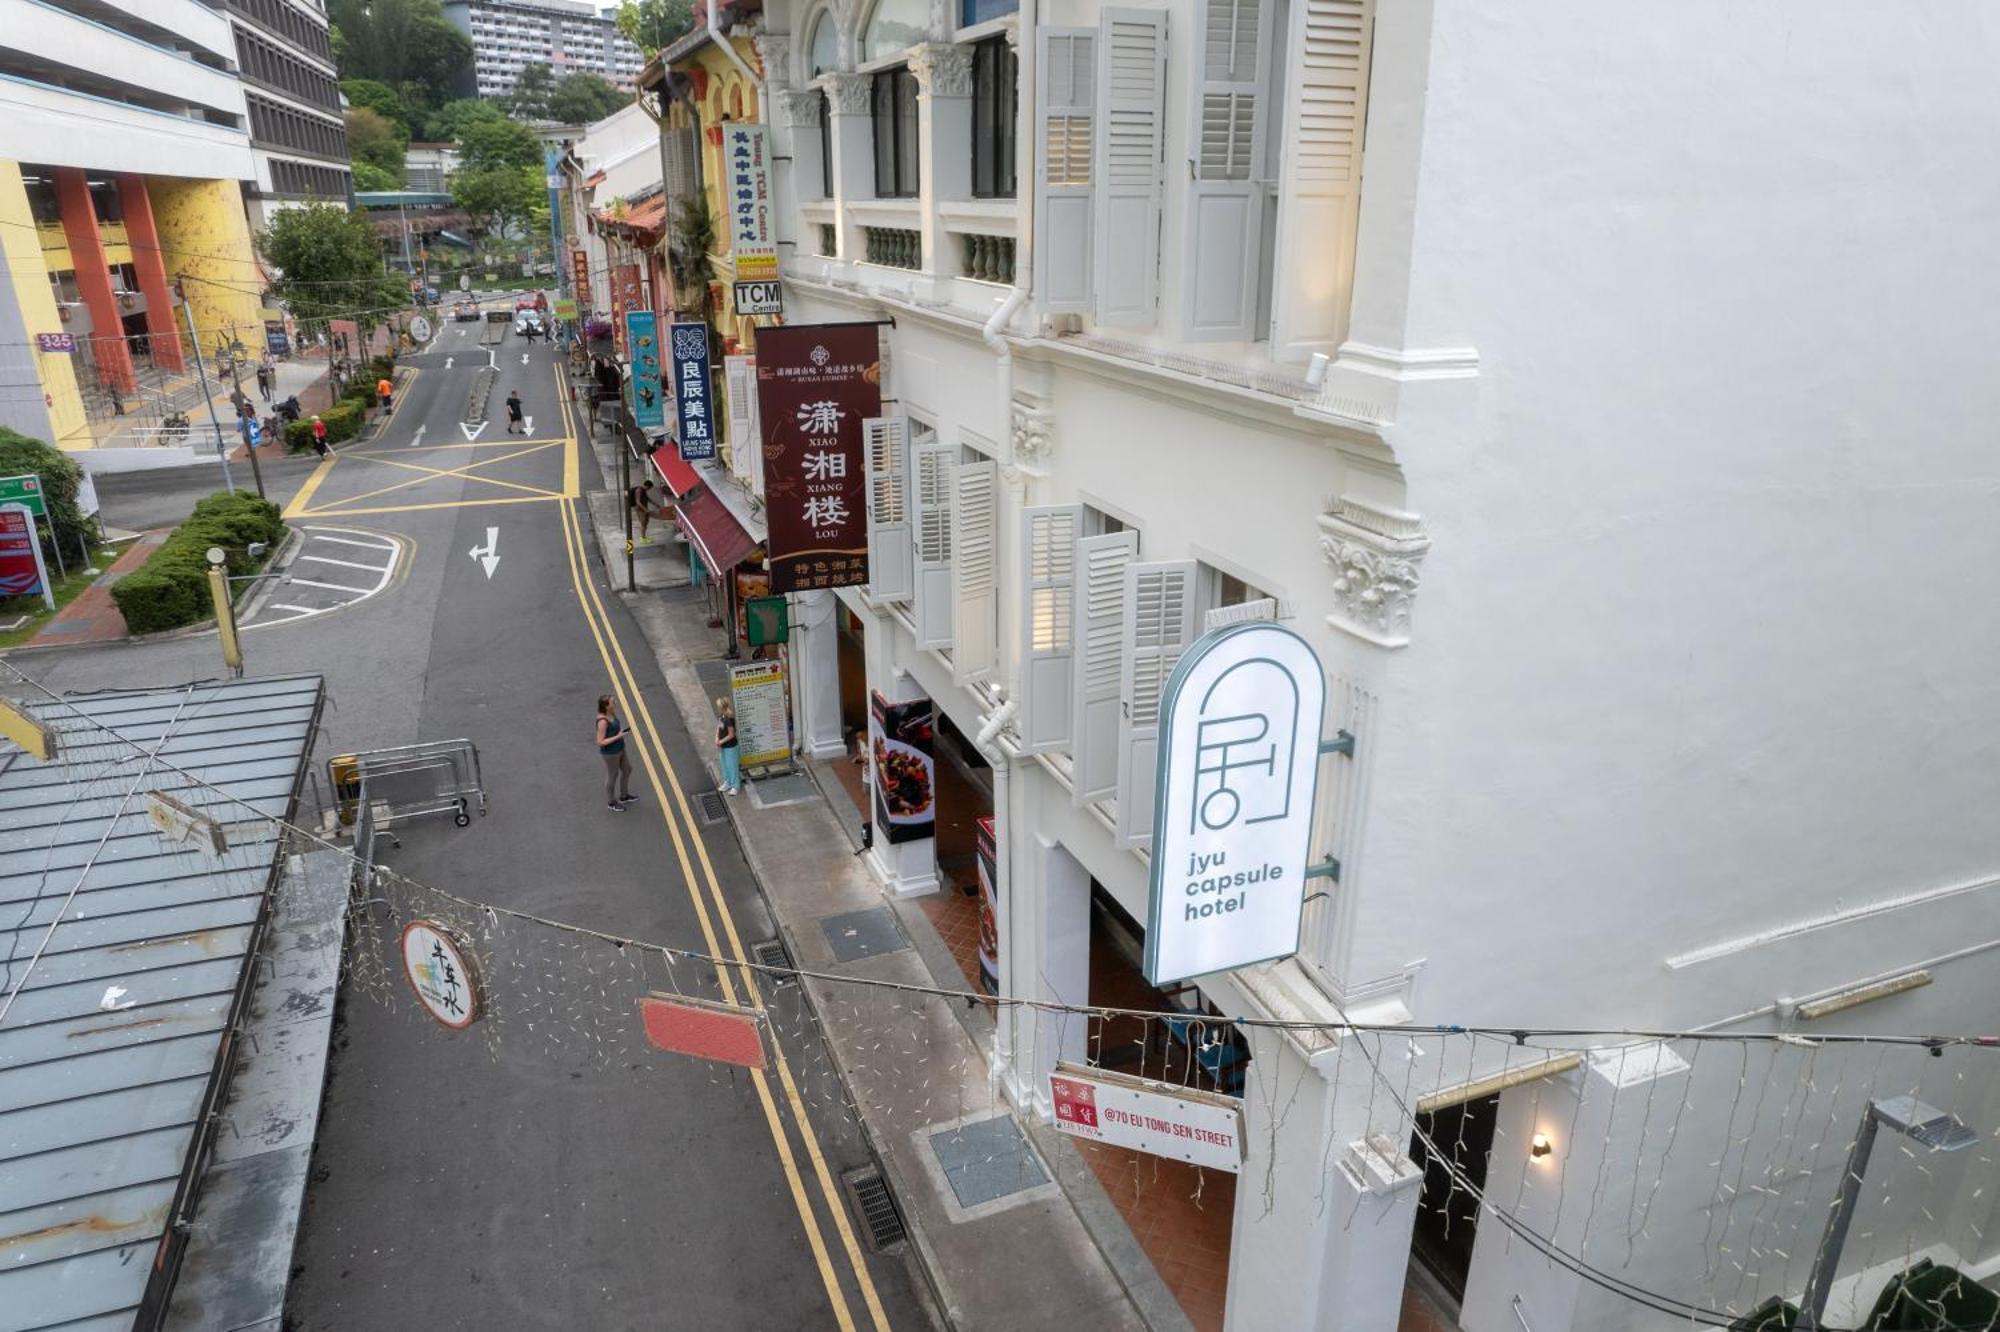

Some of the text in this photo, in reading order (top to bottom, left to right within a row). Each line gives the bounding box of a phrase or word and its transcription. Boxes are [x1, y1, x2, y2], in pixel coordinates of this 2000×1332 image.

[737, 284, 780, 304] TCM
[752, 304, 780, 313] Centre
[682, 361, 708, 438] 良辰美點
[808, 438, 838, 447] XIAO
[807, 483, 843, 493] XIANG
[815, 530, 838, 539] LOU
[1187, 851, 1225, 877] jyu
[1185, 863, 1284, 896] capsule
[1184, 891, 1246, 922] hotel
[1104, 1107, 1233, 1148] @70 EU TONG SEN STREET
